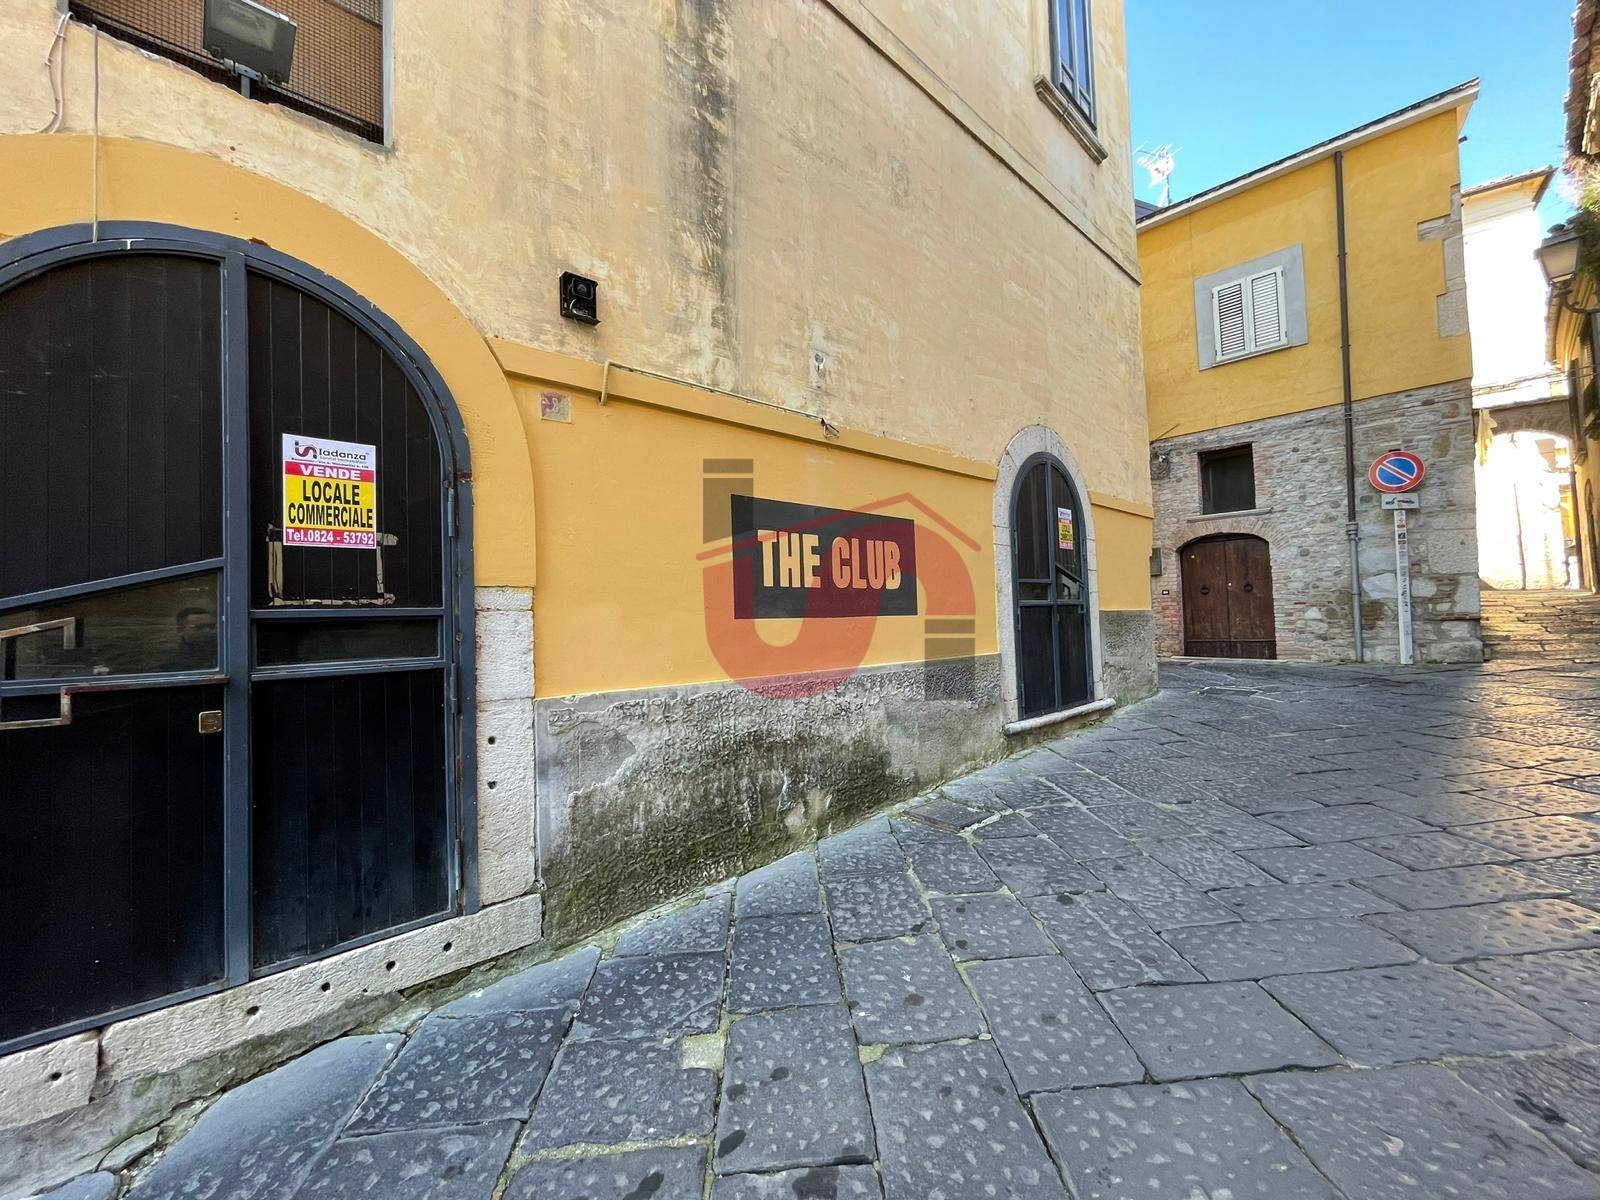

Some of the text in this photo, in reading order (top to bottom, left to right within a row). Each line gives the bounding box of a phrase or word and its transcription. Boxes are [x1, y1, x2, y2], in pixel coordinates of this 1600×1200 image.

[319, 448, 367, 461] Iadanza
[300, 464, 361, 481] VENDE
[302, 480, 360, 506] LOCALE
[288, 502, 373, 529] COMMERCIALE
[286, 529, 334, 543] Tel.0824
[343, 532, 374, 545] 53792
[757, 529, 902, 590] THE CLUB
